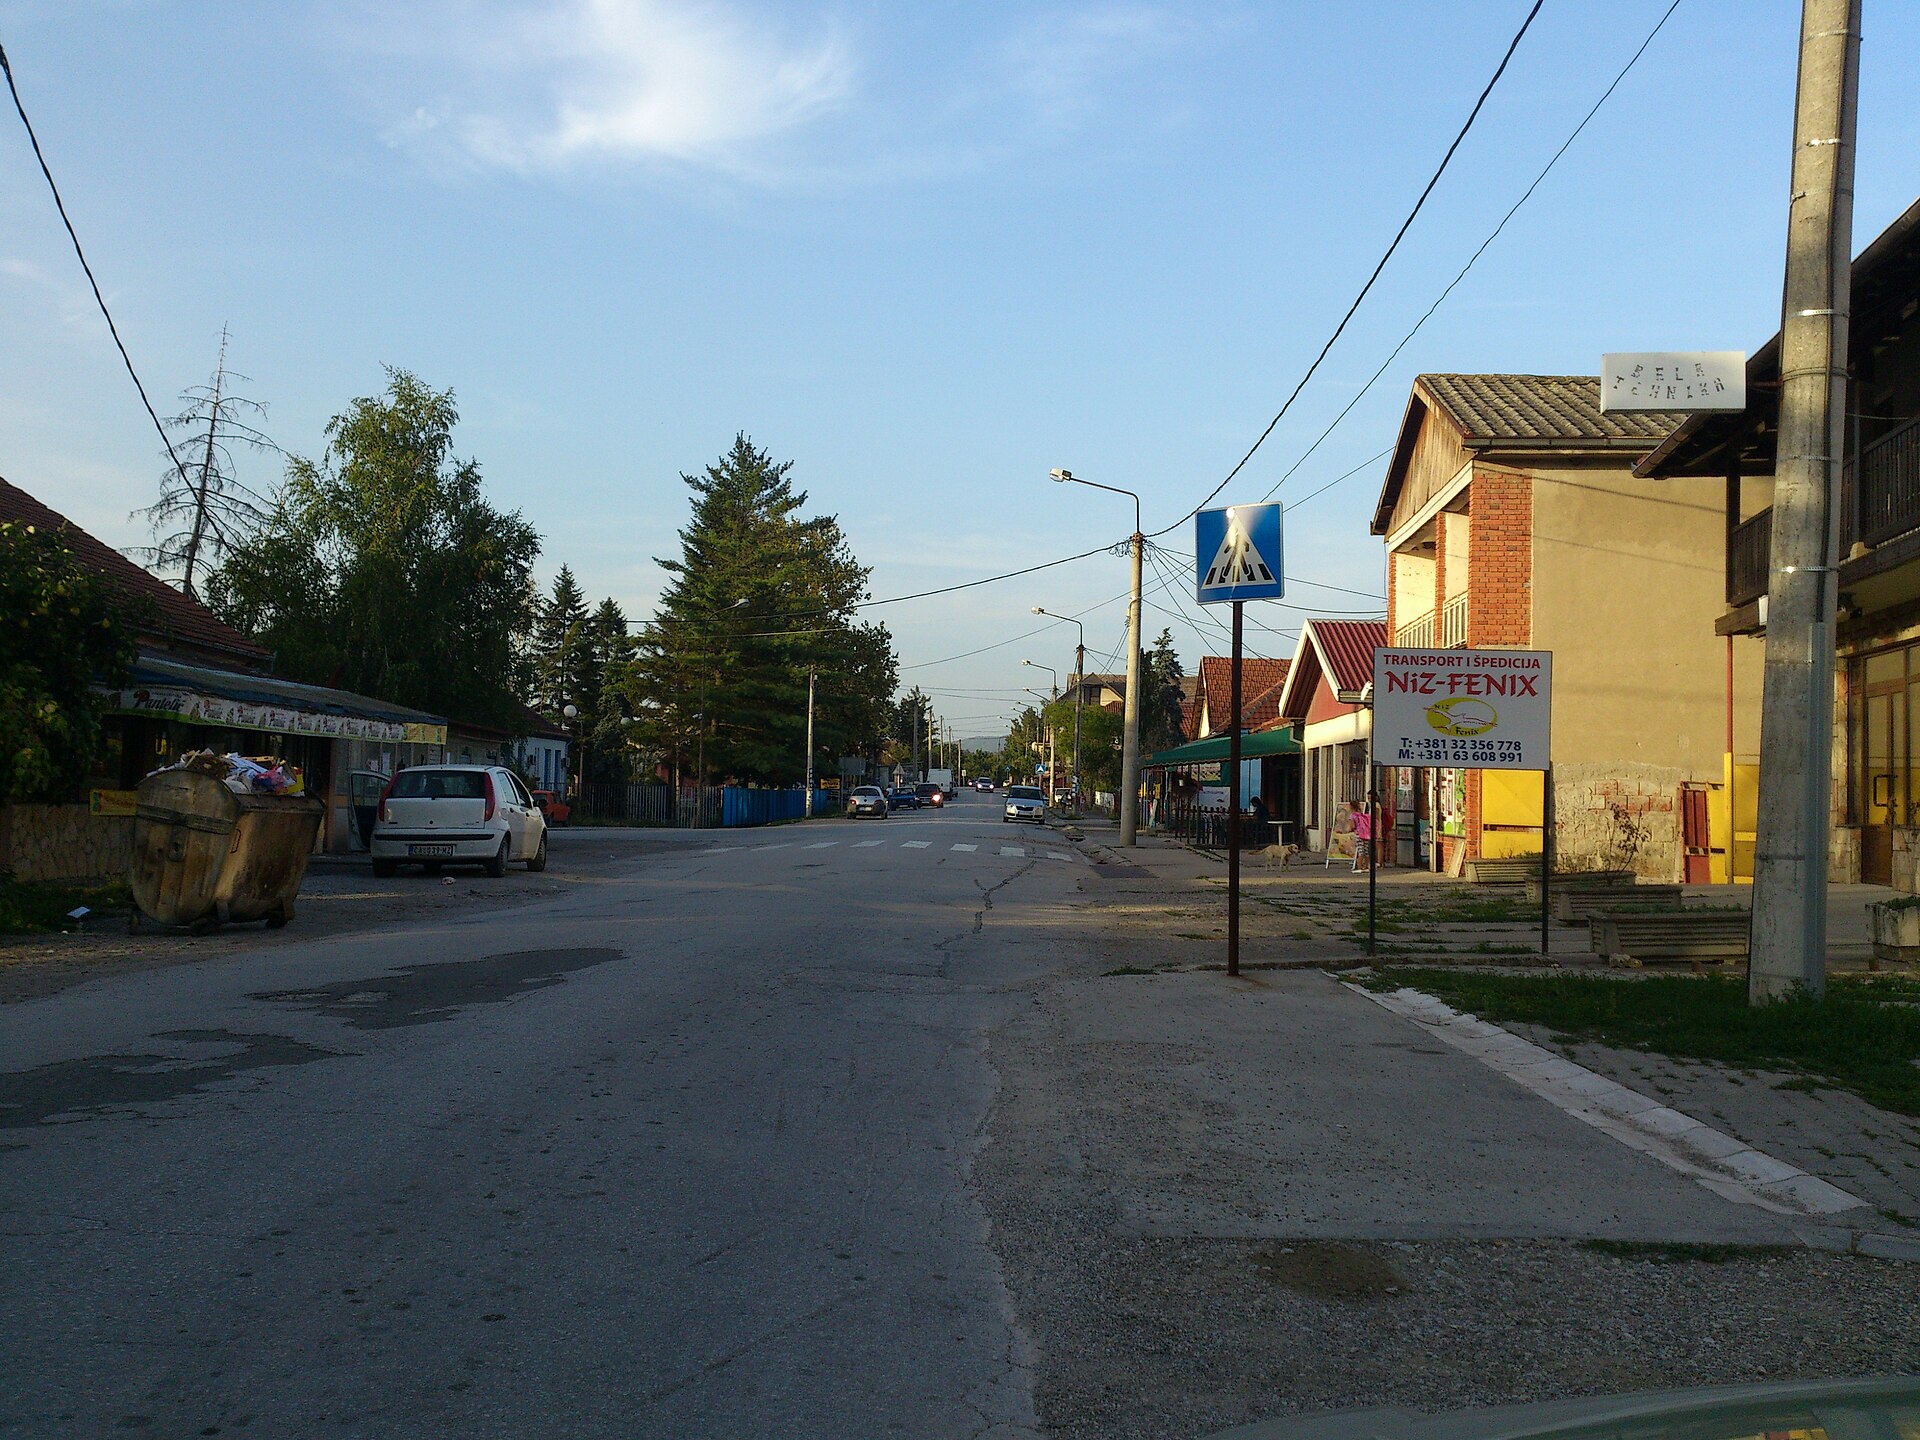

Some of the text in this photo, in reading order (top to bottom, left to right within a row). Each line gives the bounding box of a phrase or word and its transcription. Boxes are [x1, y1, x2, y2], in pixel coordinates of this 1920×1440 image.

[1383, 654, 1541, 669] TRANSPORT I ŠPEDICIJA
[1455, 726, 1479, 736] Fenix
[1400, 737, 1522, 751] T: +381 32 356 778
[1398, 749, 1523, 763] M: +381 63 608 991
